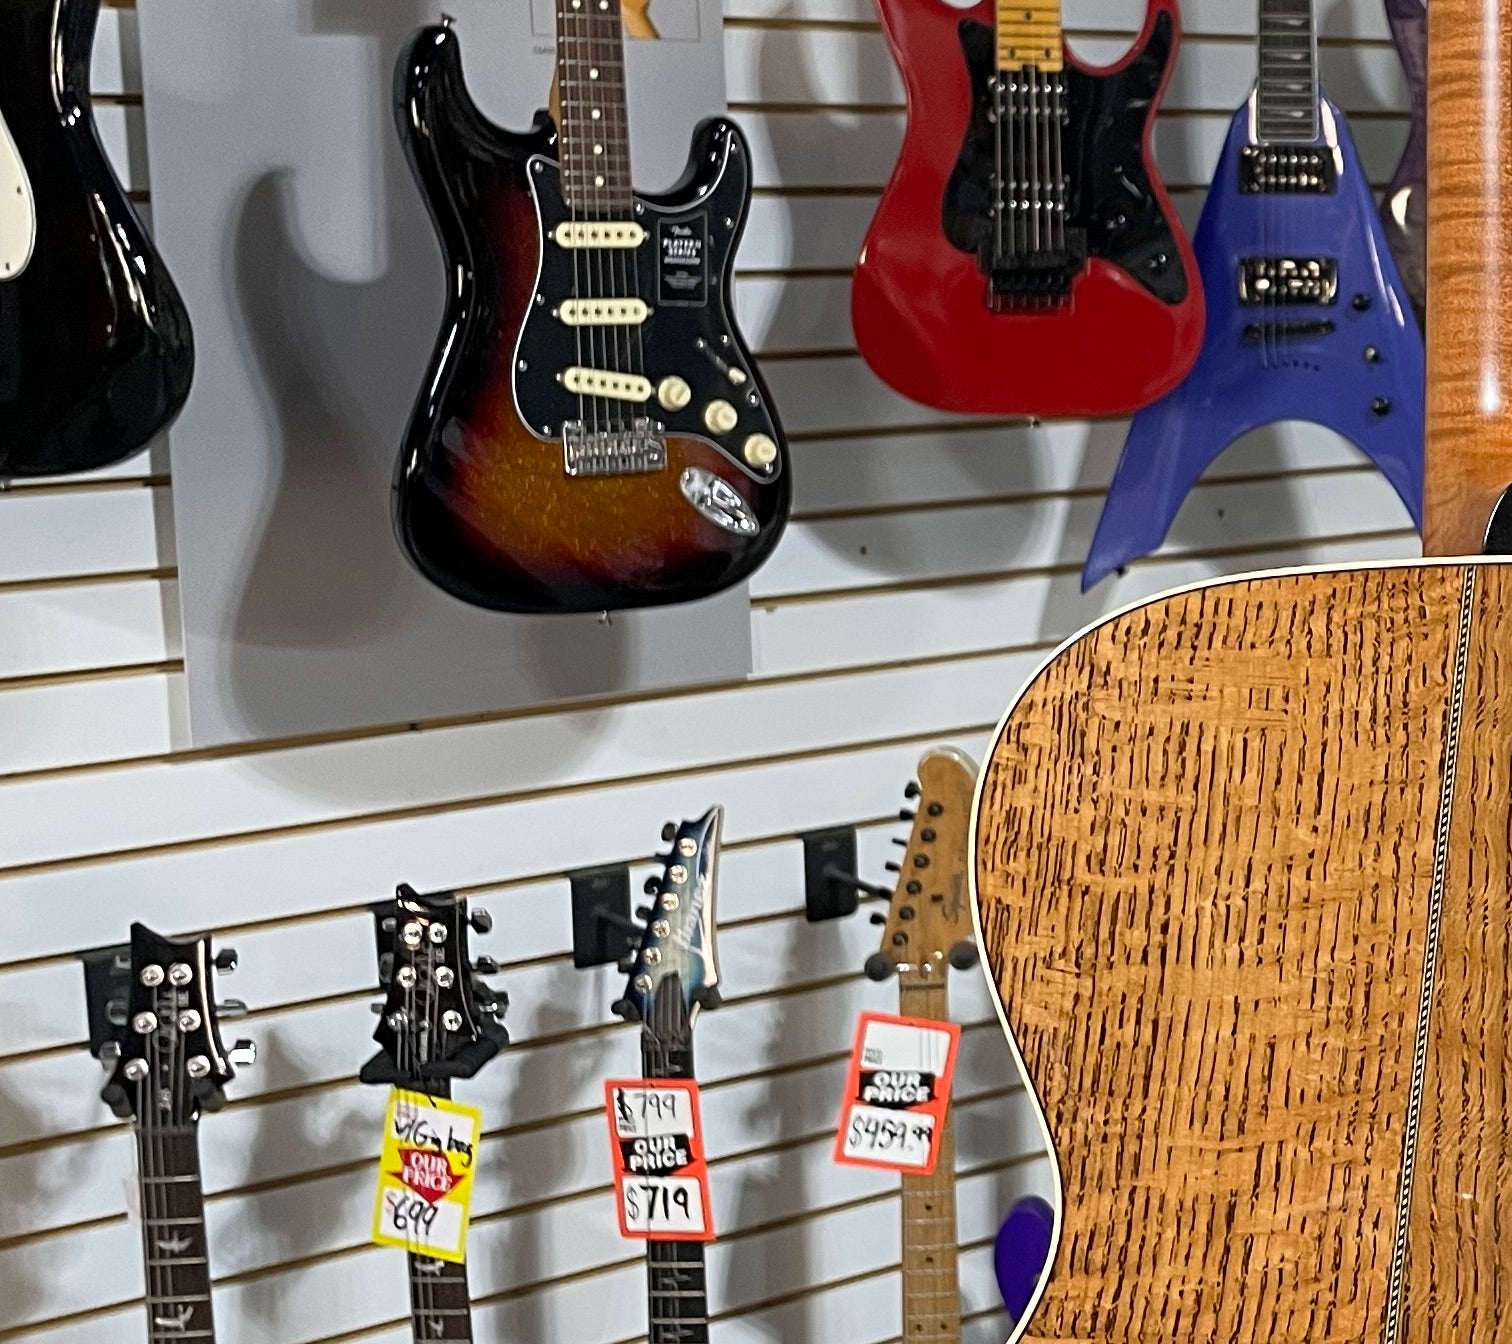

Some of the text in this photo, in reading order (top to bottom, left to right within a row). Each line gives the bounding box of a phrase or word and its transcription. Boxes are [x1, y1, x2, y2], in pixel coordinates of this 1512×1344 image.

[873, 1070, 922, 1087] OUR
[862, 1084, 931, 1103] PRICE
[632, 1134, 677, 1156] OUR
[410, 1150, 448, 1174] OUR
[628, 1147, 689, 1173] PRICE
[401, 1163, 453, 1193] PRICE
[626, 1183, 691, 1224] $719
